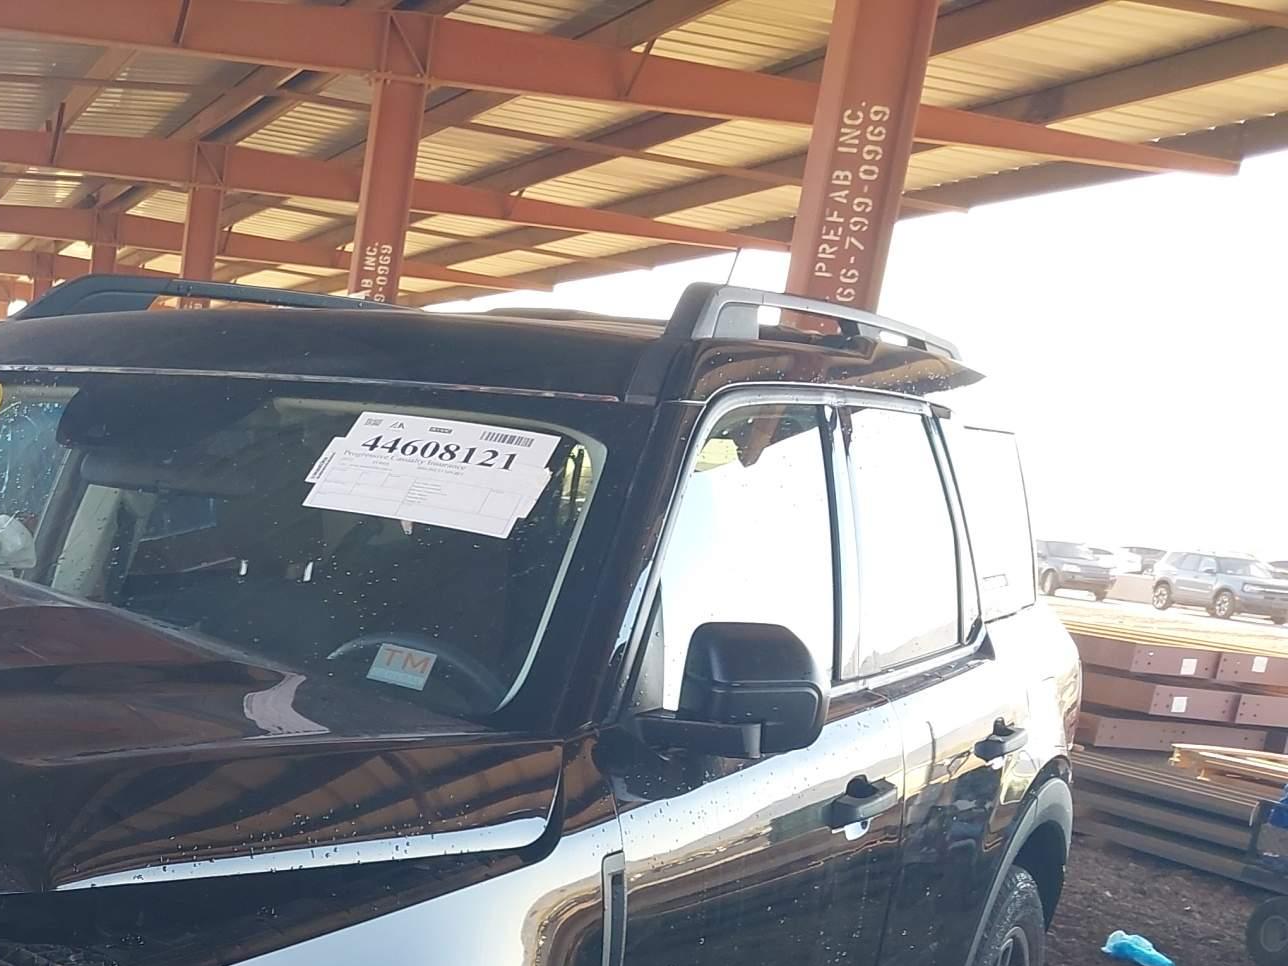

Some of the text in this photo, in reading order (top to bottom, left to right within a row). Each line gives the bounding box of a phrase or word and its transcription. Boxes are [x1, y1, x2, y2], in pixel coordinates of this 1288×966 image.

[815, 100, 867, 277] PREFAB INC.
[363, 241, 379, 271] INC.
[361, 434, 520, 471] 44608121
